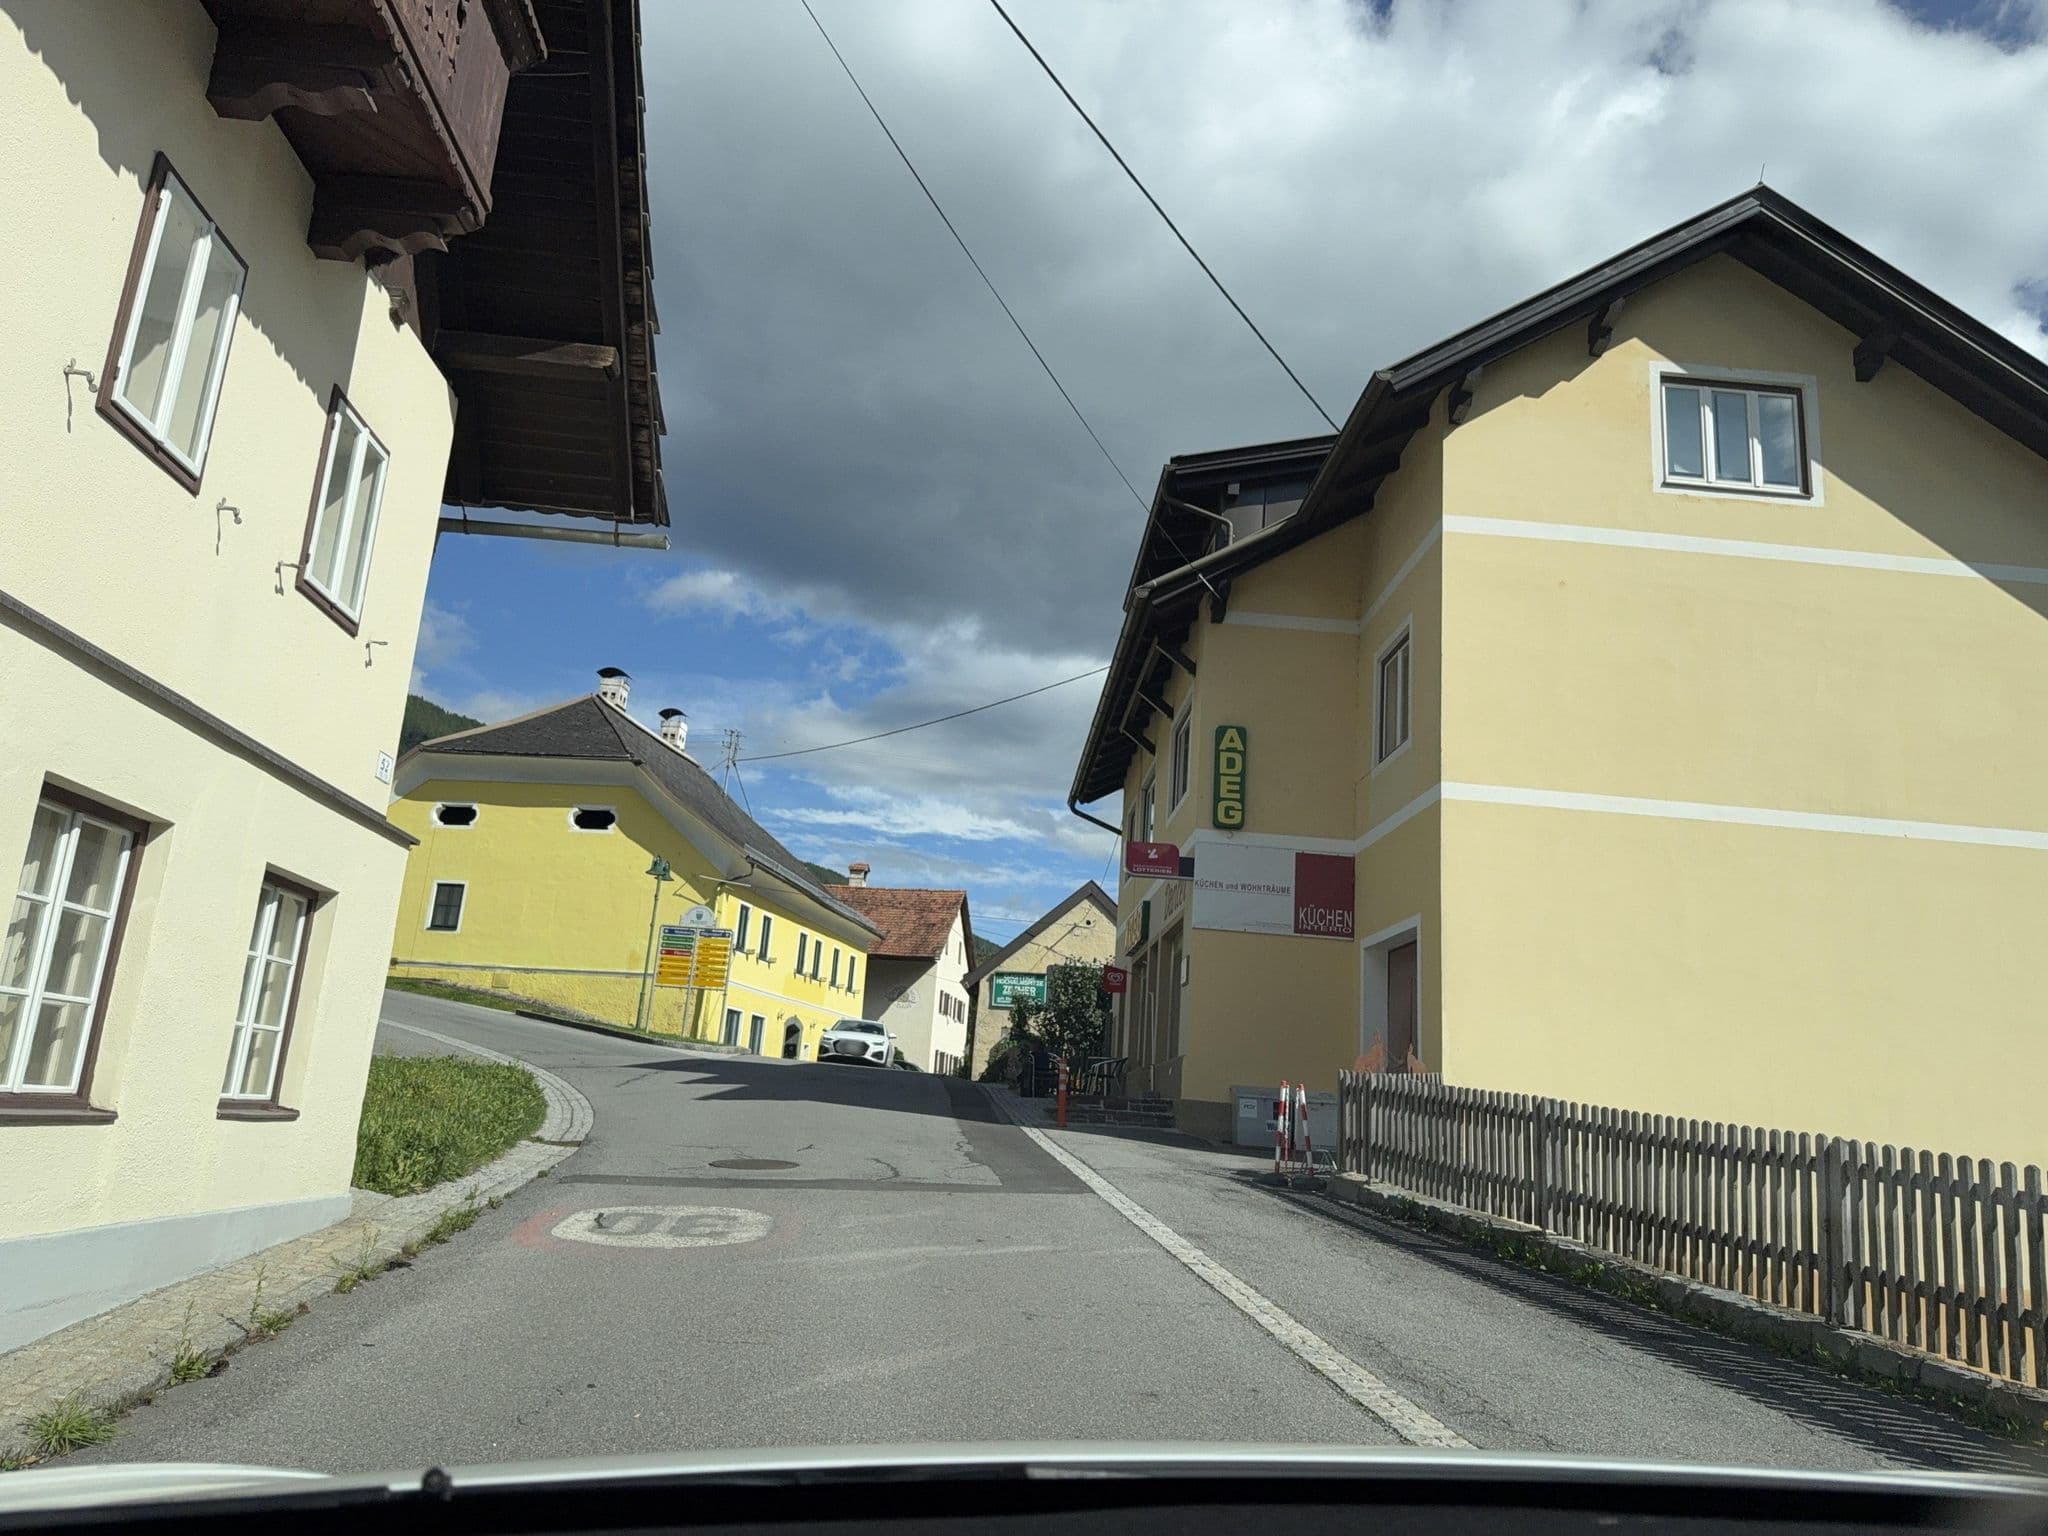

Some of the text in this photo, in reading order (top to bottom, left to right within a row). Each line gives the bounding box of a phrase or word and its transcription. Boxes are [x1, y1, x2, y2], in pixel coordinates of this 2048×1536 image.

[1217, 728, 1245, 825] ADEG
[1195, 879, 1292, 895] KÜCHEN und WOHNTRÄUME
[1299, 904, 1353, 928] KÜCHEN
[1299, 924, 1352, 934] INTERIO
